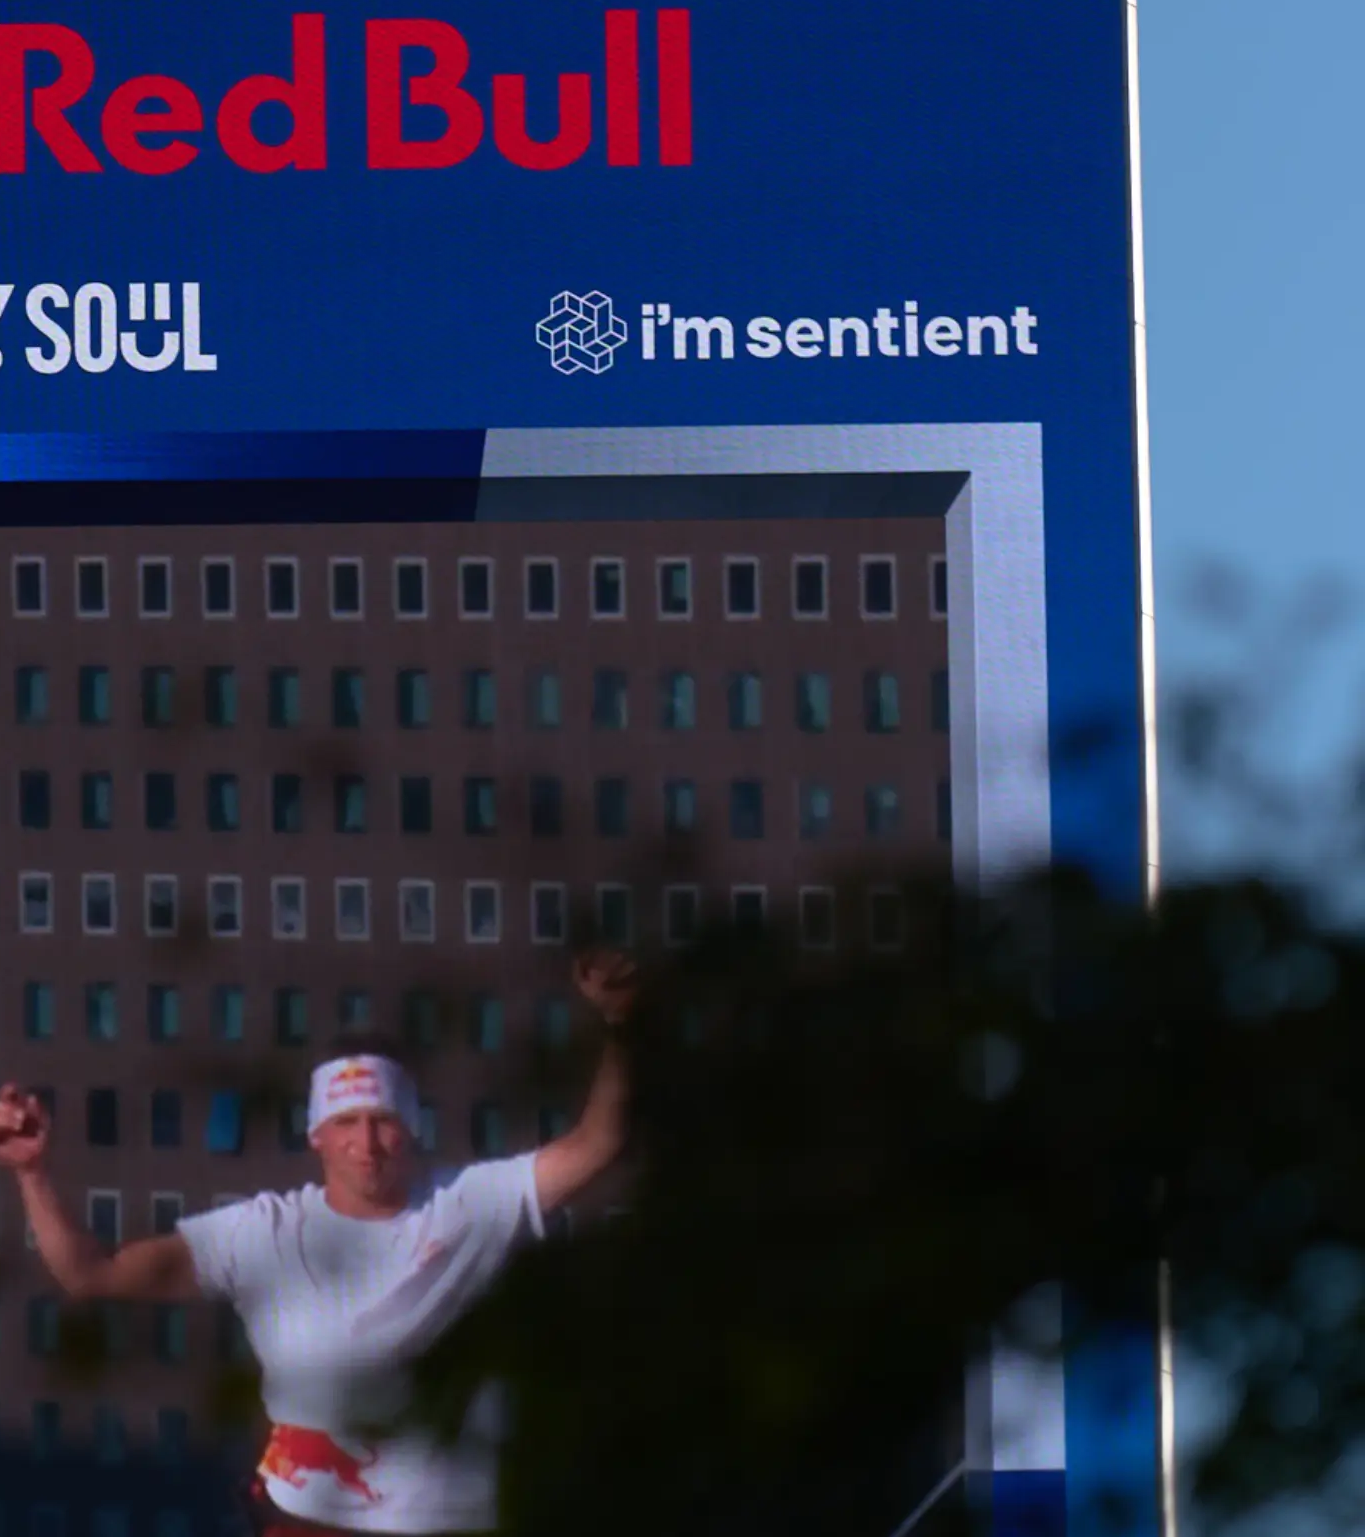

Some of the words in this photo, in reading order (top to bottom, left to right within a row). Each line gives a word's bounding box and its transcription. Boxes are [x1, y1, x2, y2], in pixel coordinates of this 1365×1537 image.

[365, 8, 692, 171] Bull
[641, 303, 735, 360] i'm
[745, 300, 1038, 358] sentient
